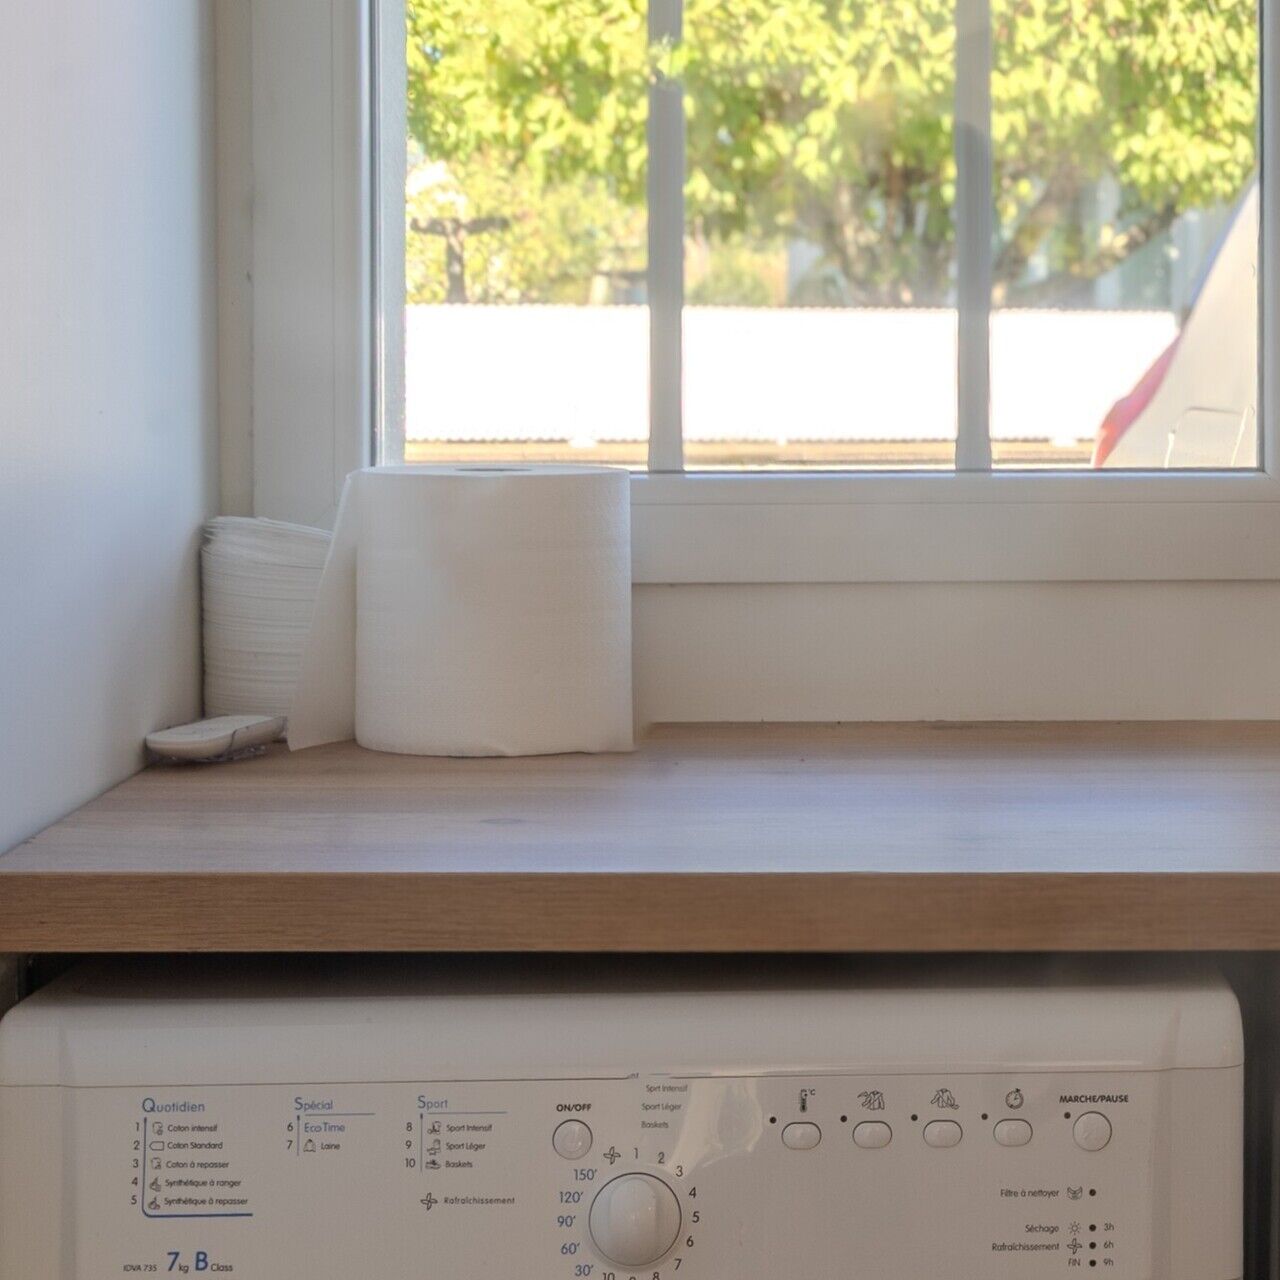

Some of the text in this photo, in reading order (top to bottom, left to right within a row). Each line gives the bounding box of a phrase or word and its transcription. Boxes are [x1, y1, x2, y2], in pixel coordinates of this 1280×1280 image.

[294, 1097, 333, 1111] Spécial
[418, 1095, 448, 1110] Sport
[1060, 1094, 1129, 1104] MARCHE/PAUSE
[142, 1097, 205, 1113] Quotidien
[556, 1104, 592, 1112] ON/OFF
[287, 1123, 293, 1132] 6
[406, 1122, 412, 1132] 8
[446, 1124, 465, 1132] Sport
[133, 1140, 140, 1150] 2
[286, 1141, 341, 1150] 7 Laine
[405, 1140, 412, 1149] 9
[446, 1142, 464, 1150] Sport
[658, 1152, 665, 1163] 2
[133, 1159, 139, 1168] 3
[405, 1158, 416, 1168] 10
[676, 1165, 683, 1177] 3
[131, 1177, 138, 1186] 4
[689, 1187, 697, 1199] 4
[1028, 1189, 1059, 1199] nettoyer
[131, 1195, 137, 1205] 5
[692, 1211, 700, 1223] 5
[686, 1236, 694, 1248] 6
[195, 1251, 208, 1271] B
[211, 1263, 233, 1272] Class
[674, 1259, 682, 1271] 7
